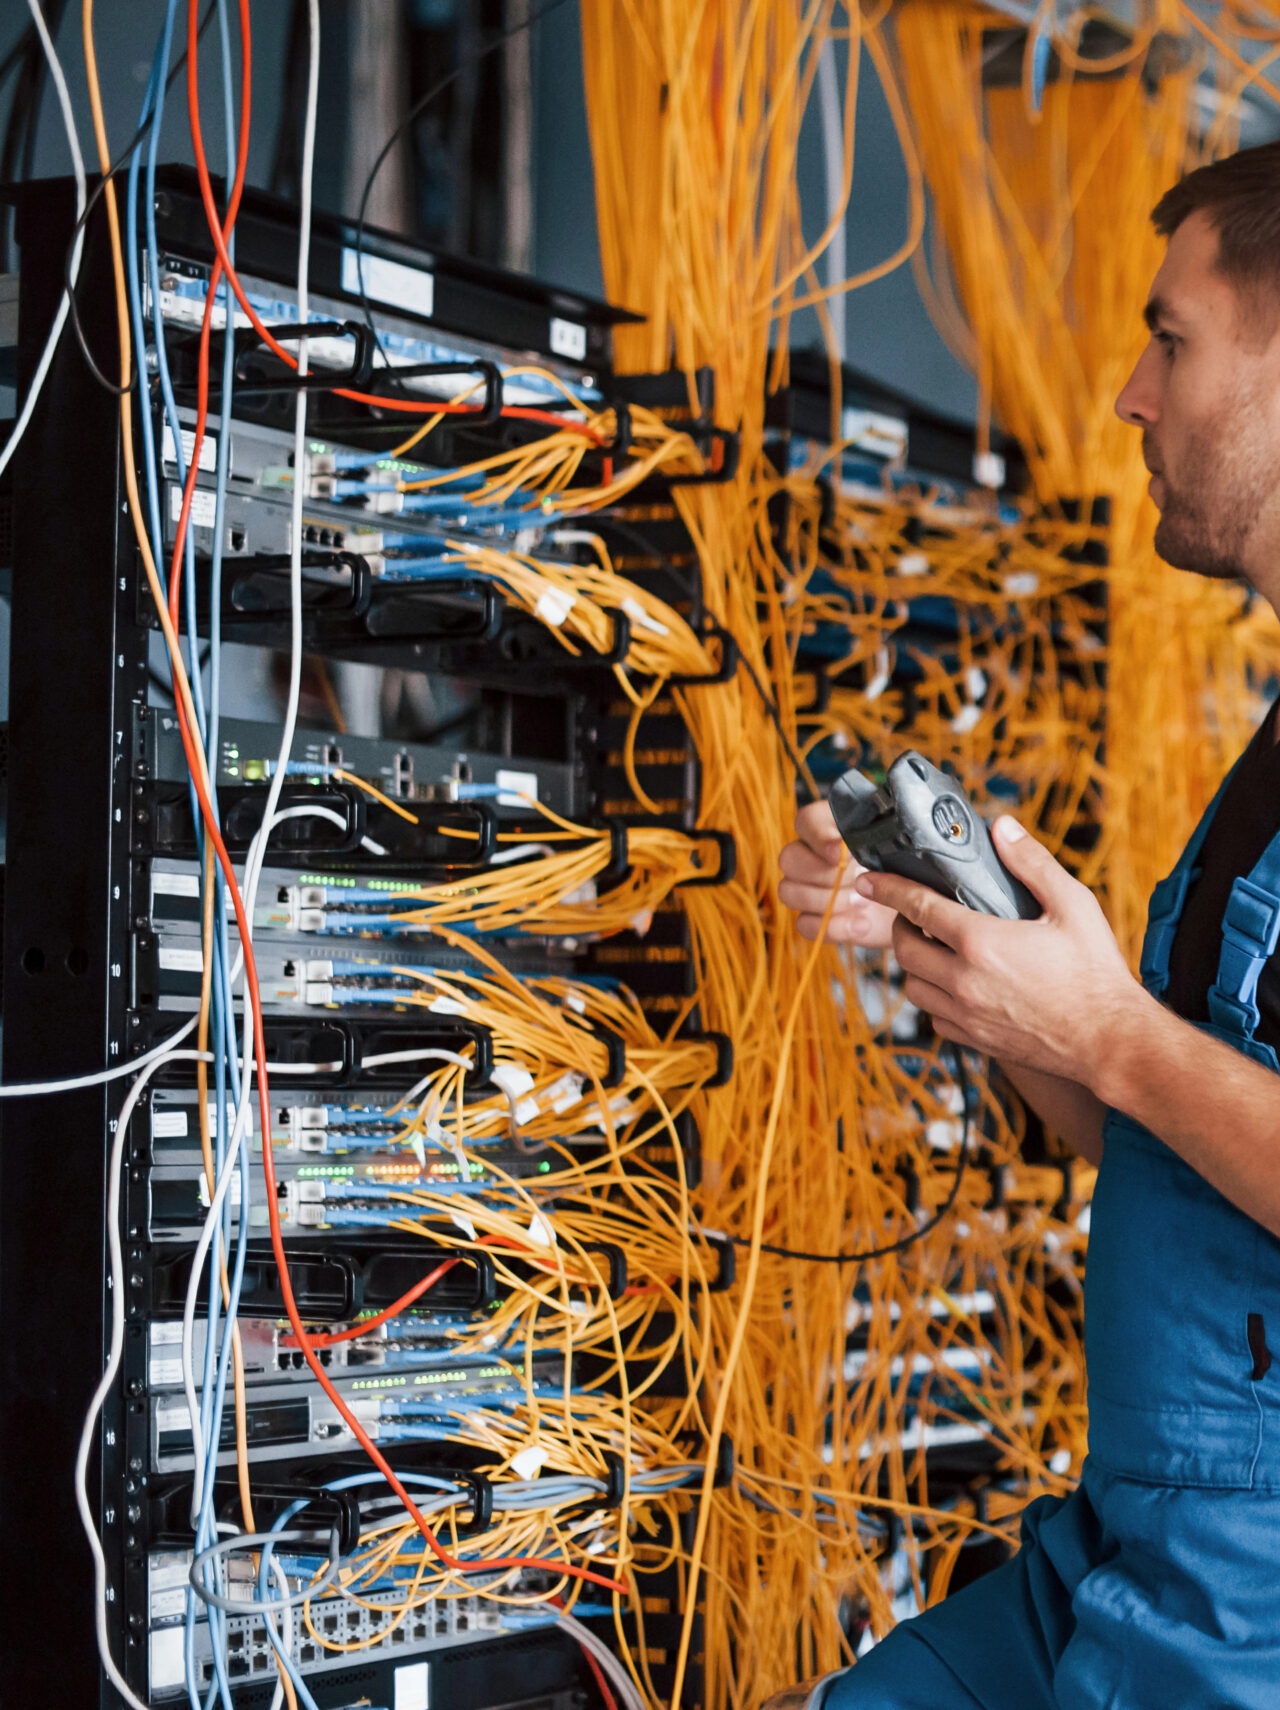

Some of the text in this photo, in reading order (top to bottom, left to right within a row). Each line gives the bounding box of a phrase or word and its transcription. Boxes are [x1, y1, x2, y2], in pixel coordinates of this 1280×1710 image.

[120, 577, 126, 591] 5
[118, 654, 125, 668] 6
[116, 731, 123, 744] 7
[115, 808, 121, 822] 8
[113, 886, 120, 900] 9
[111, 964, 120, 977] 10
[110, 1041, 119, 1055] 11
[109, 1120, 118, 1133] 12
[106, 1431, 115, 1445] 16
[106, 1510, 115, 1523] 17
[106, 1587, 115, 1600] 18
